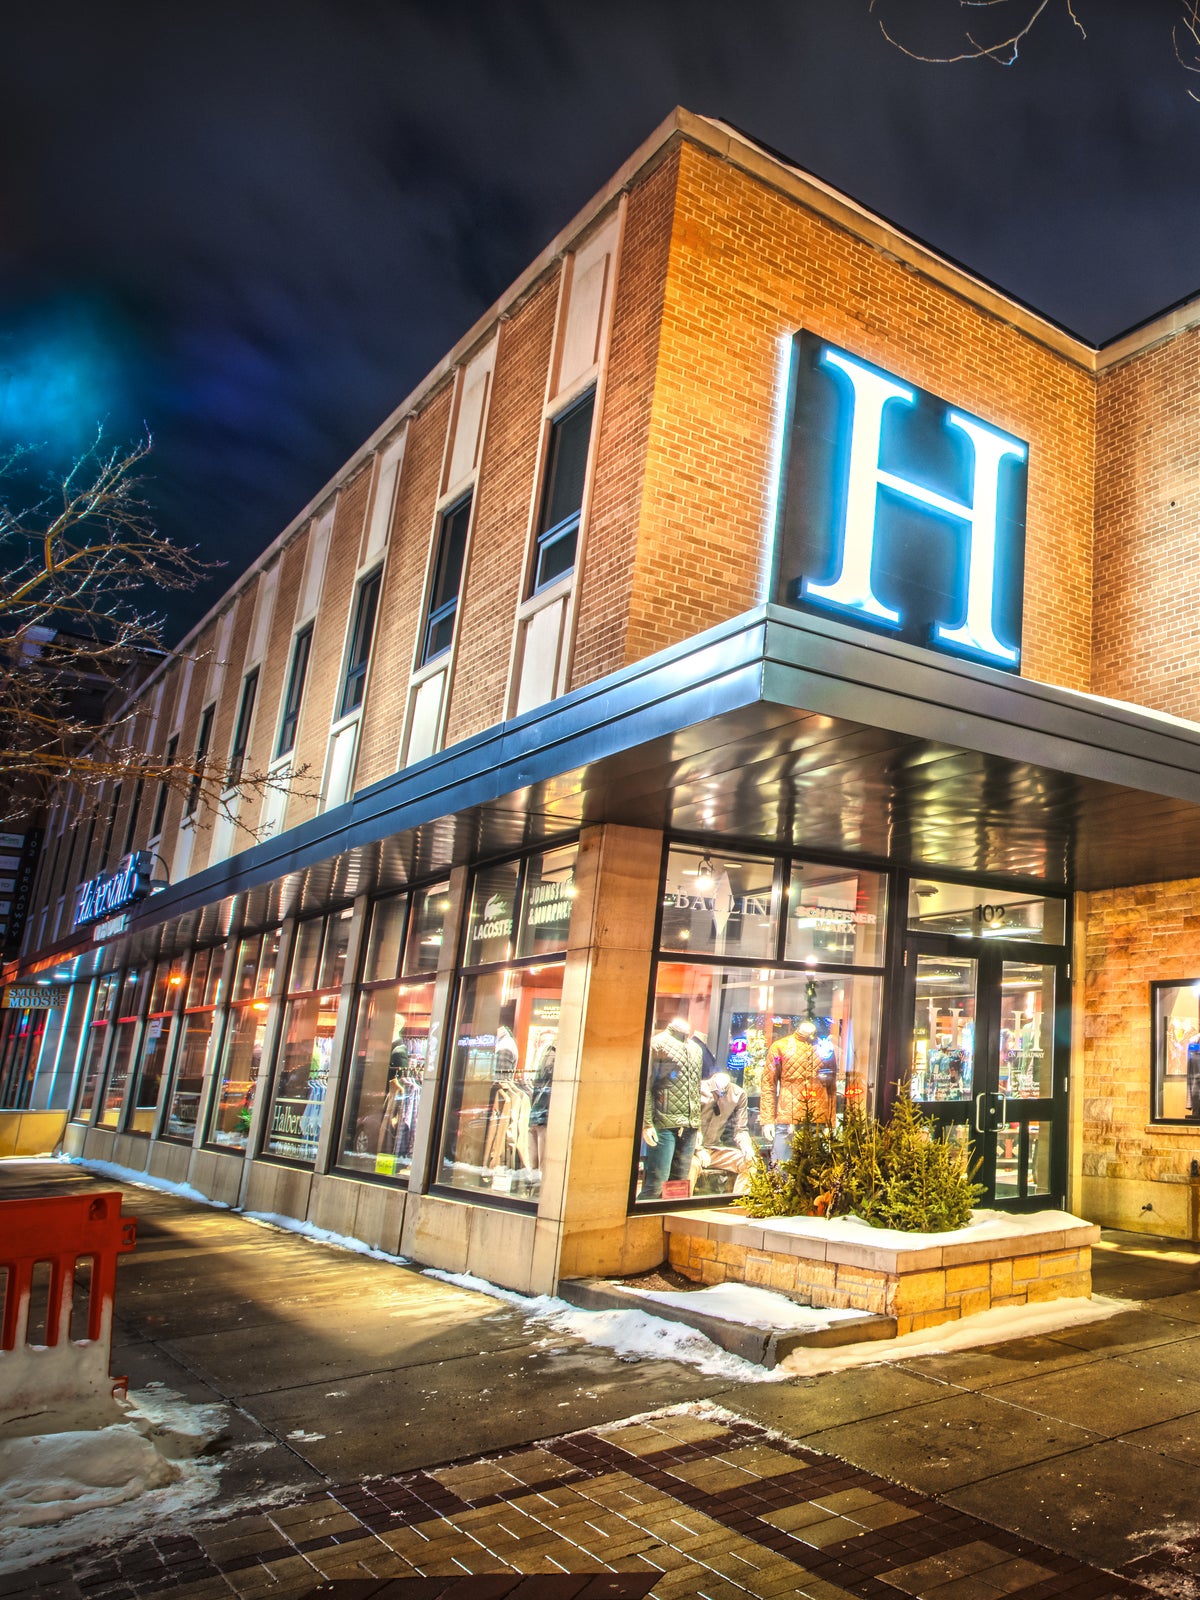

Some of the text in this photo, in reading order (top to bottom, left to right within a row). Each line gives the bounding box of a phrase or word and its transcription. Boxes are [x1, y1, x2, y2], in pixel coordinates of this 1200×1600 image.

[804, 348, 1026, 664] H
[12, 831, 38, 937] 102 BROADWAY
[796, 906, 877, 924] SCHAFFNER
[975, 904, 1006, 924] 102
[473, 918, 513, 941] LACOSTE
[815, 920, 857, 934] MARX
[9, 988, 59, 998] SMILING
[9, 996, 59, 1008] MOOSE
